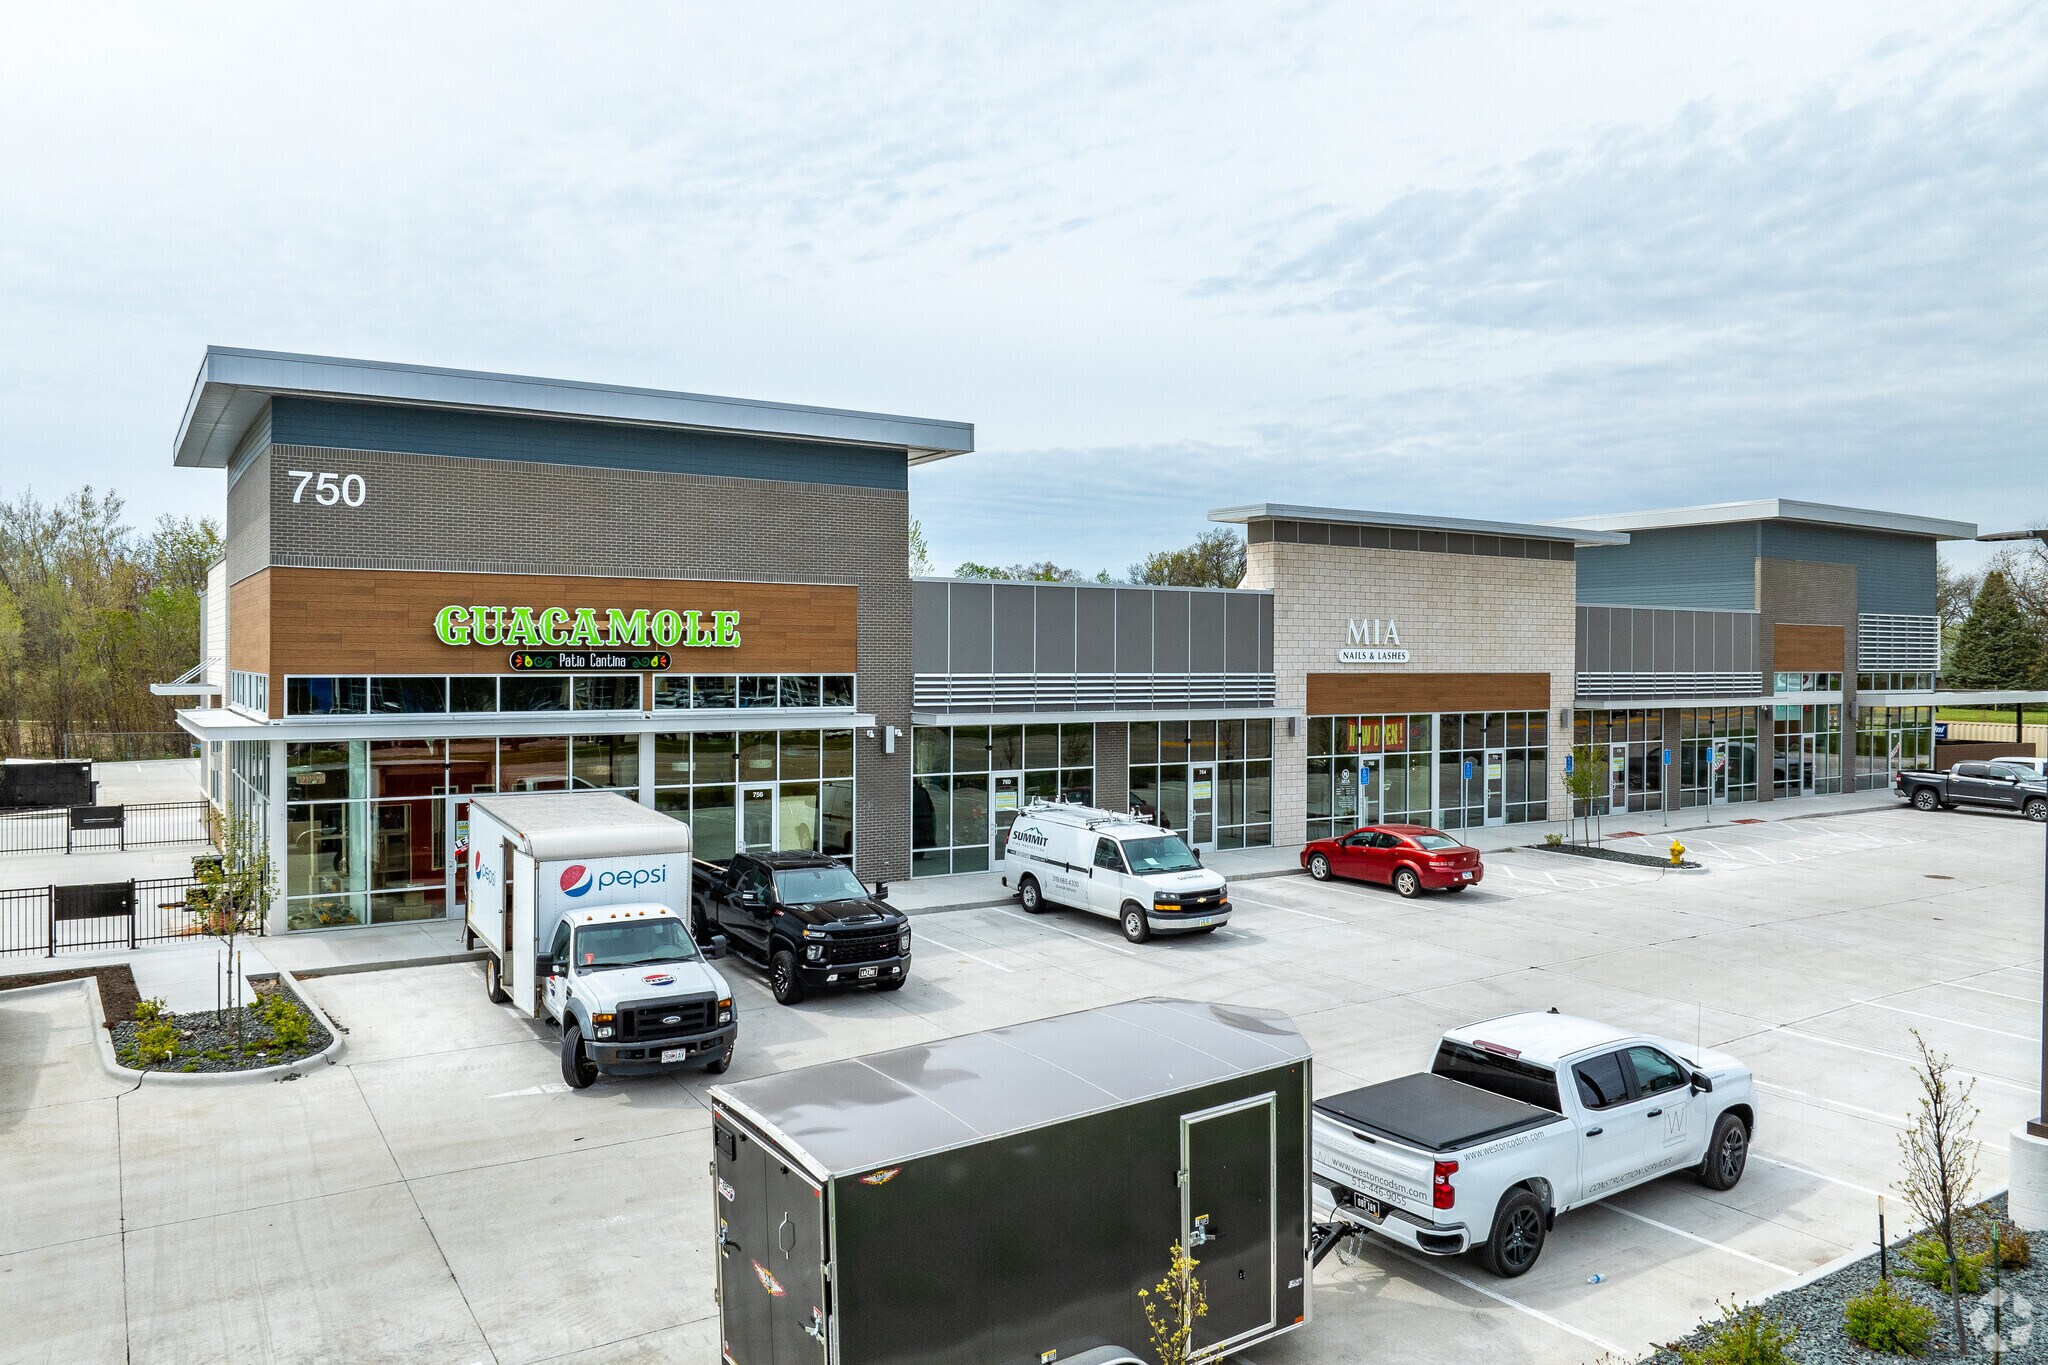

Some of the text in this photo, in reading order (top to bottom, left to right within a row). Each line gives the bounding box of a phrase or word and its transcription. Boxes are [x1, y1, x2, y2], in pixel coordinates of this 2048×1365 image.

[288, 470, 366, 507] 750
[433, 605, 741, 648] GUACAMOLE
[1346, 618, 1400, 645] MIA
[559, 653, 626, 667] Patio Cantina
[1343, 652, 1406, 660] NAILS & LASHES
[1349, 724, 1371, 747] NW
[1012, 831, 1048, 847] SUMMIT
[598, 864, 666, 891] pepsi
[1464, 1131, 1545, 1161] www.westoncodsm.com
[1332, 1158, 1428, 1201] www.westoncodsm.com
[1589, 1157, 1673, 1192] CONSTRUCTION SERVICES
[1352, 1176, 1407, 1207] 515-446-9055
